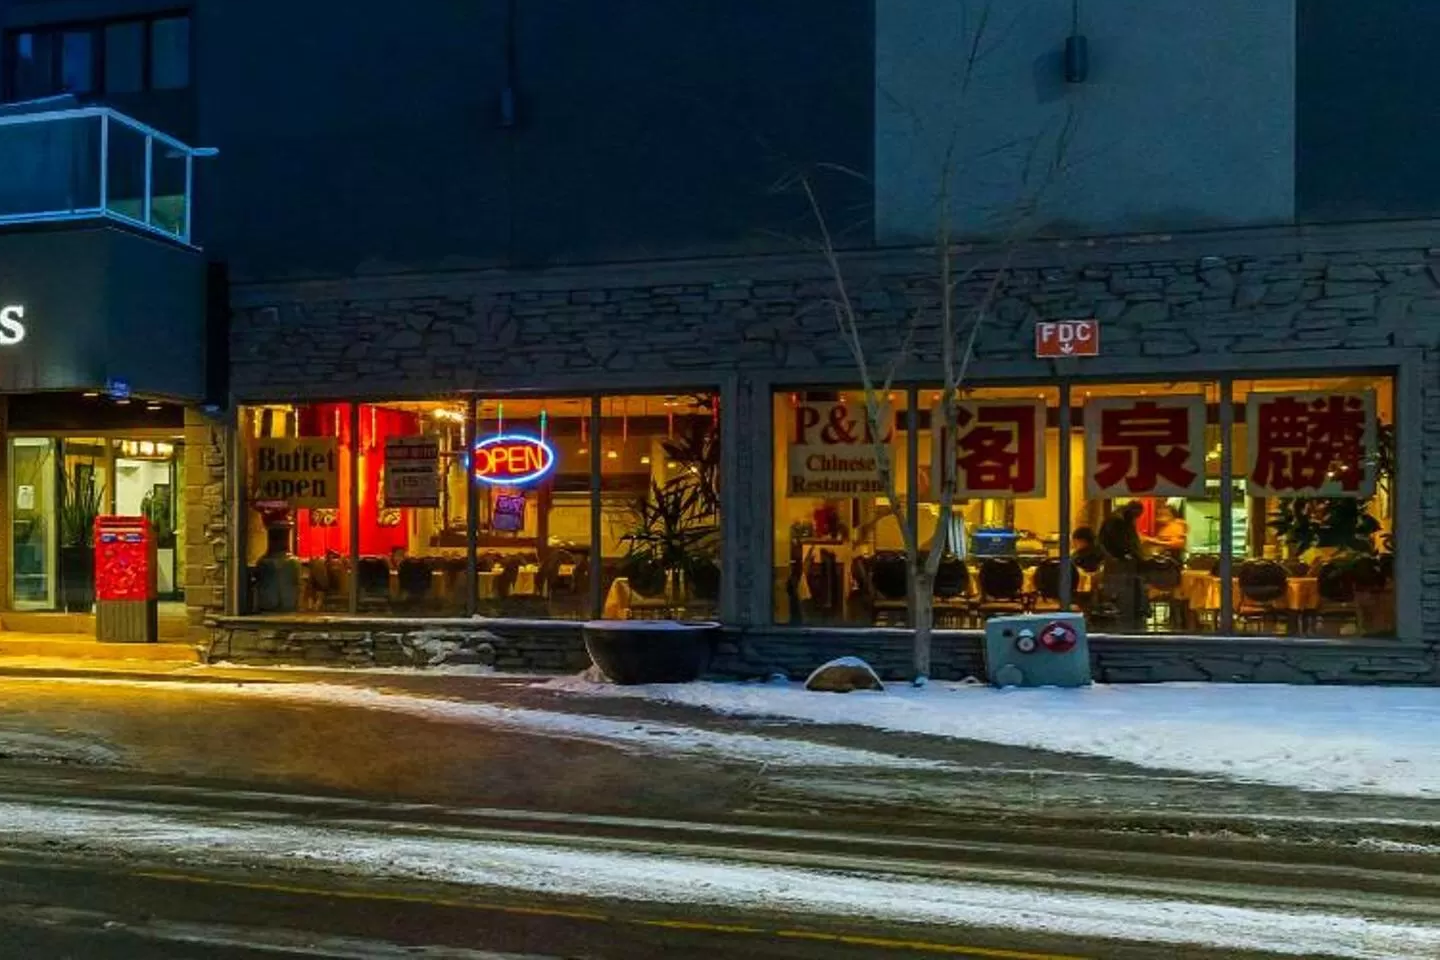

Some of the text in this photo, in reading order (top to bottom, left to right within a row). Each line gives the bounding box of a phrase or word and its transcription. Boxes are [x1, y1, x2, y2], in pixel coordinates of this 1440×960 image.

[1041, 322, 1091, 343] FDC
[259, 447, 336, 472] Buffet
[475, 446, 543, 475] OPEN
[806, 454, 877, 472] Chinese
